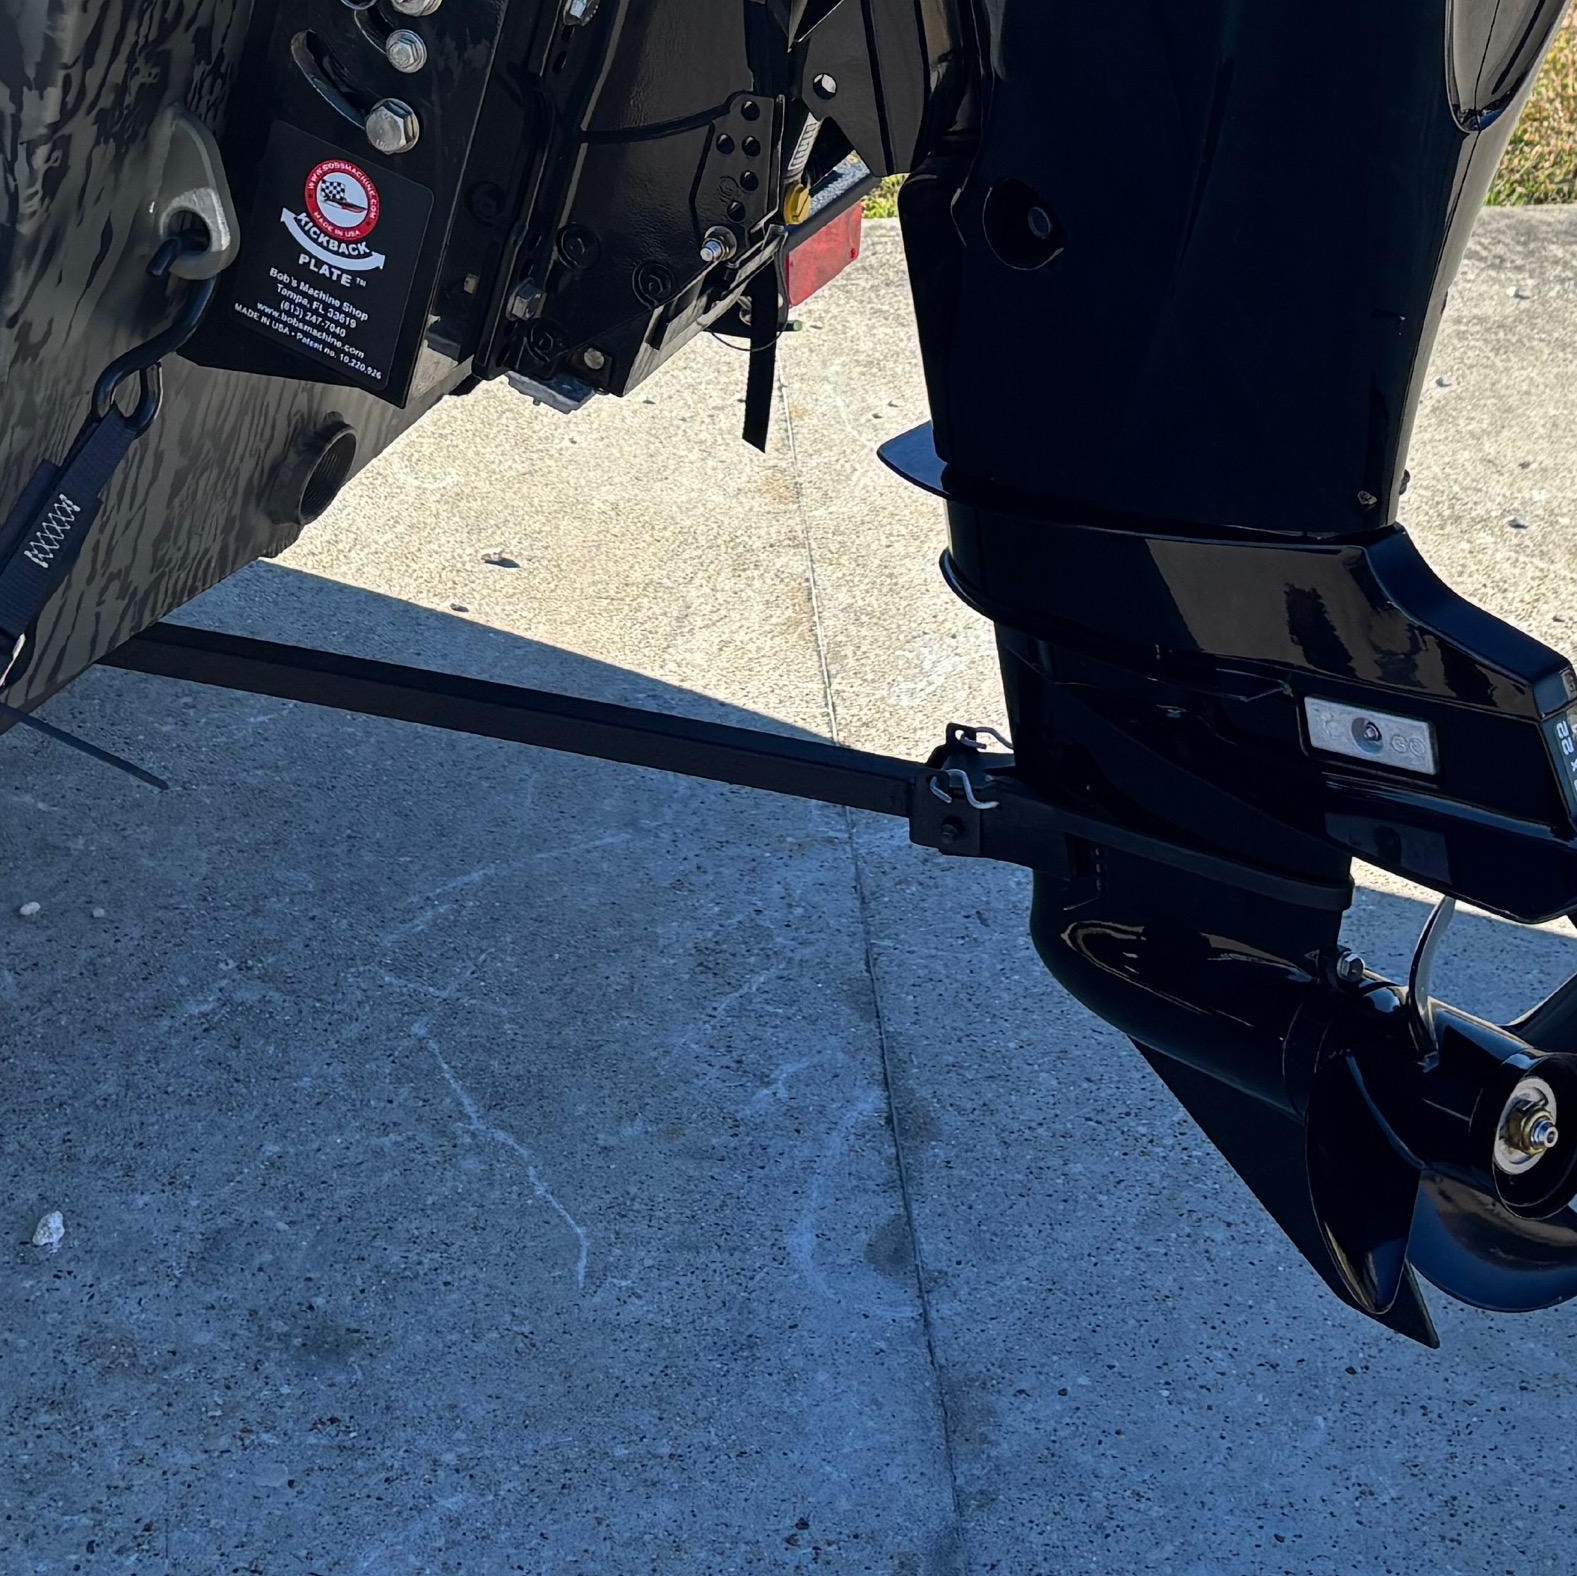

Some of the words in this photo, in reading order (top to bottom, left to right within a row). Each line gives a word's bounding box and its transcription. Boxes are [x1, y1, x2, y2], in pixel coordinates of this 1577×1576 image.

[296, 212, 371, 256] KICKBACK
[344, 230, 361, 238] USA
[298, 253, 352, 287] PLATE
[269, 267, 297, 287] Bob's
[299, 278, 340, 308] Machine
[342, 301, 369, 322] Shop
[312, 300, 325, 314] FL
[234, 302, 260, 321] MADE
[260, 314, 271, 326] IN
[271, 321, 290, 336] USA
[296, 332, 323, 352] Patent
[1556, 720, 1575, 755] 22
